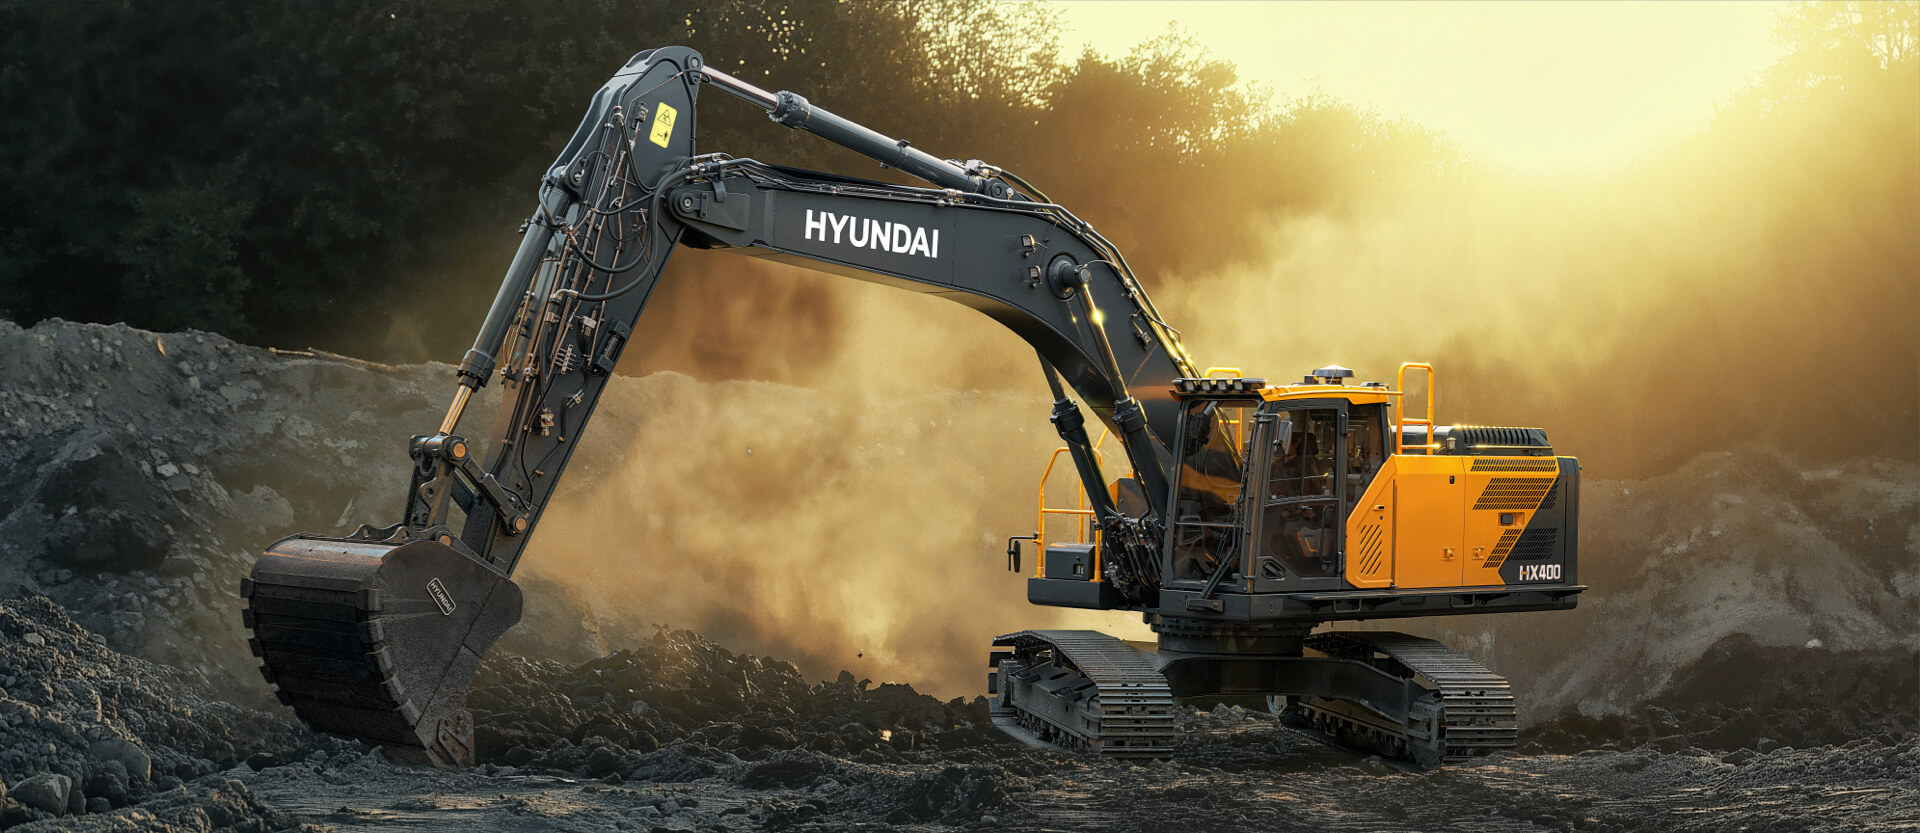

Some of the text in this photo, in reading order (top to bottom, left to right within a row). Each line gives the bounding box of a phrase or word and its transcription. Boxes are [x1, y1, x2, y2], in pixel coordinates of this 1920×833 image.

[805, 209, 939, 258] HYUNDAI
[1519, 564, 1561, 581] HX400
[430, 581, 453, 612] HYUNDAI
